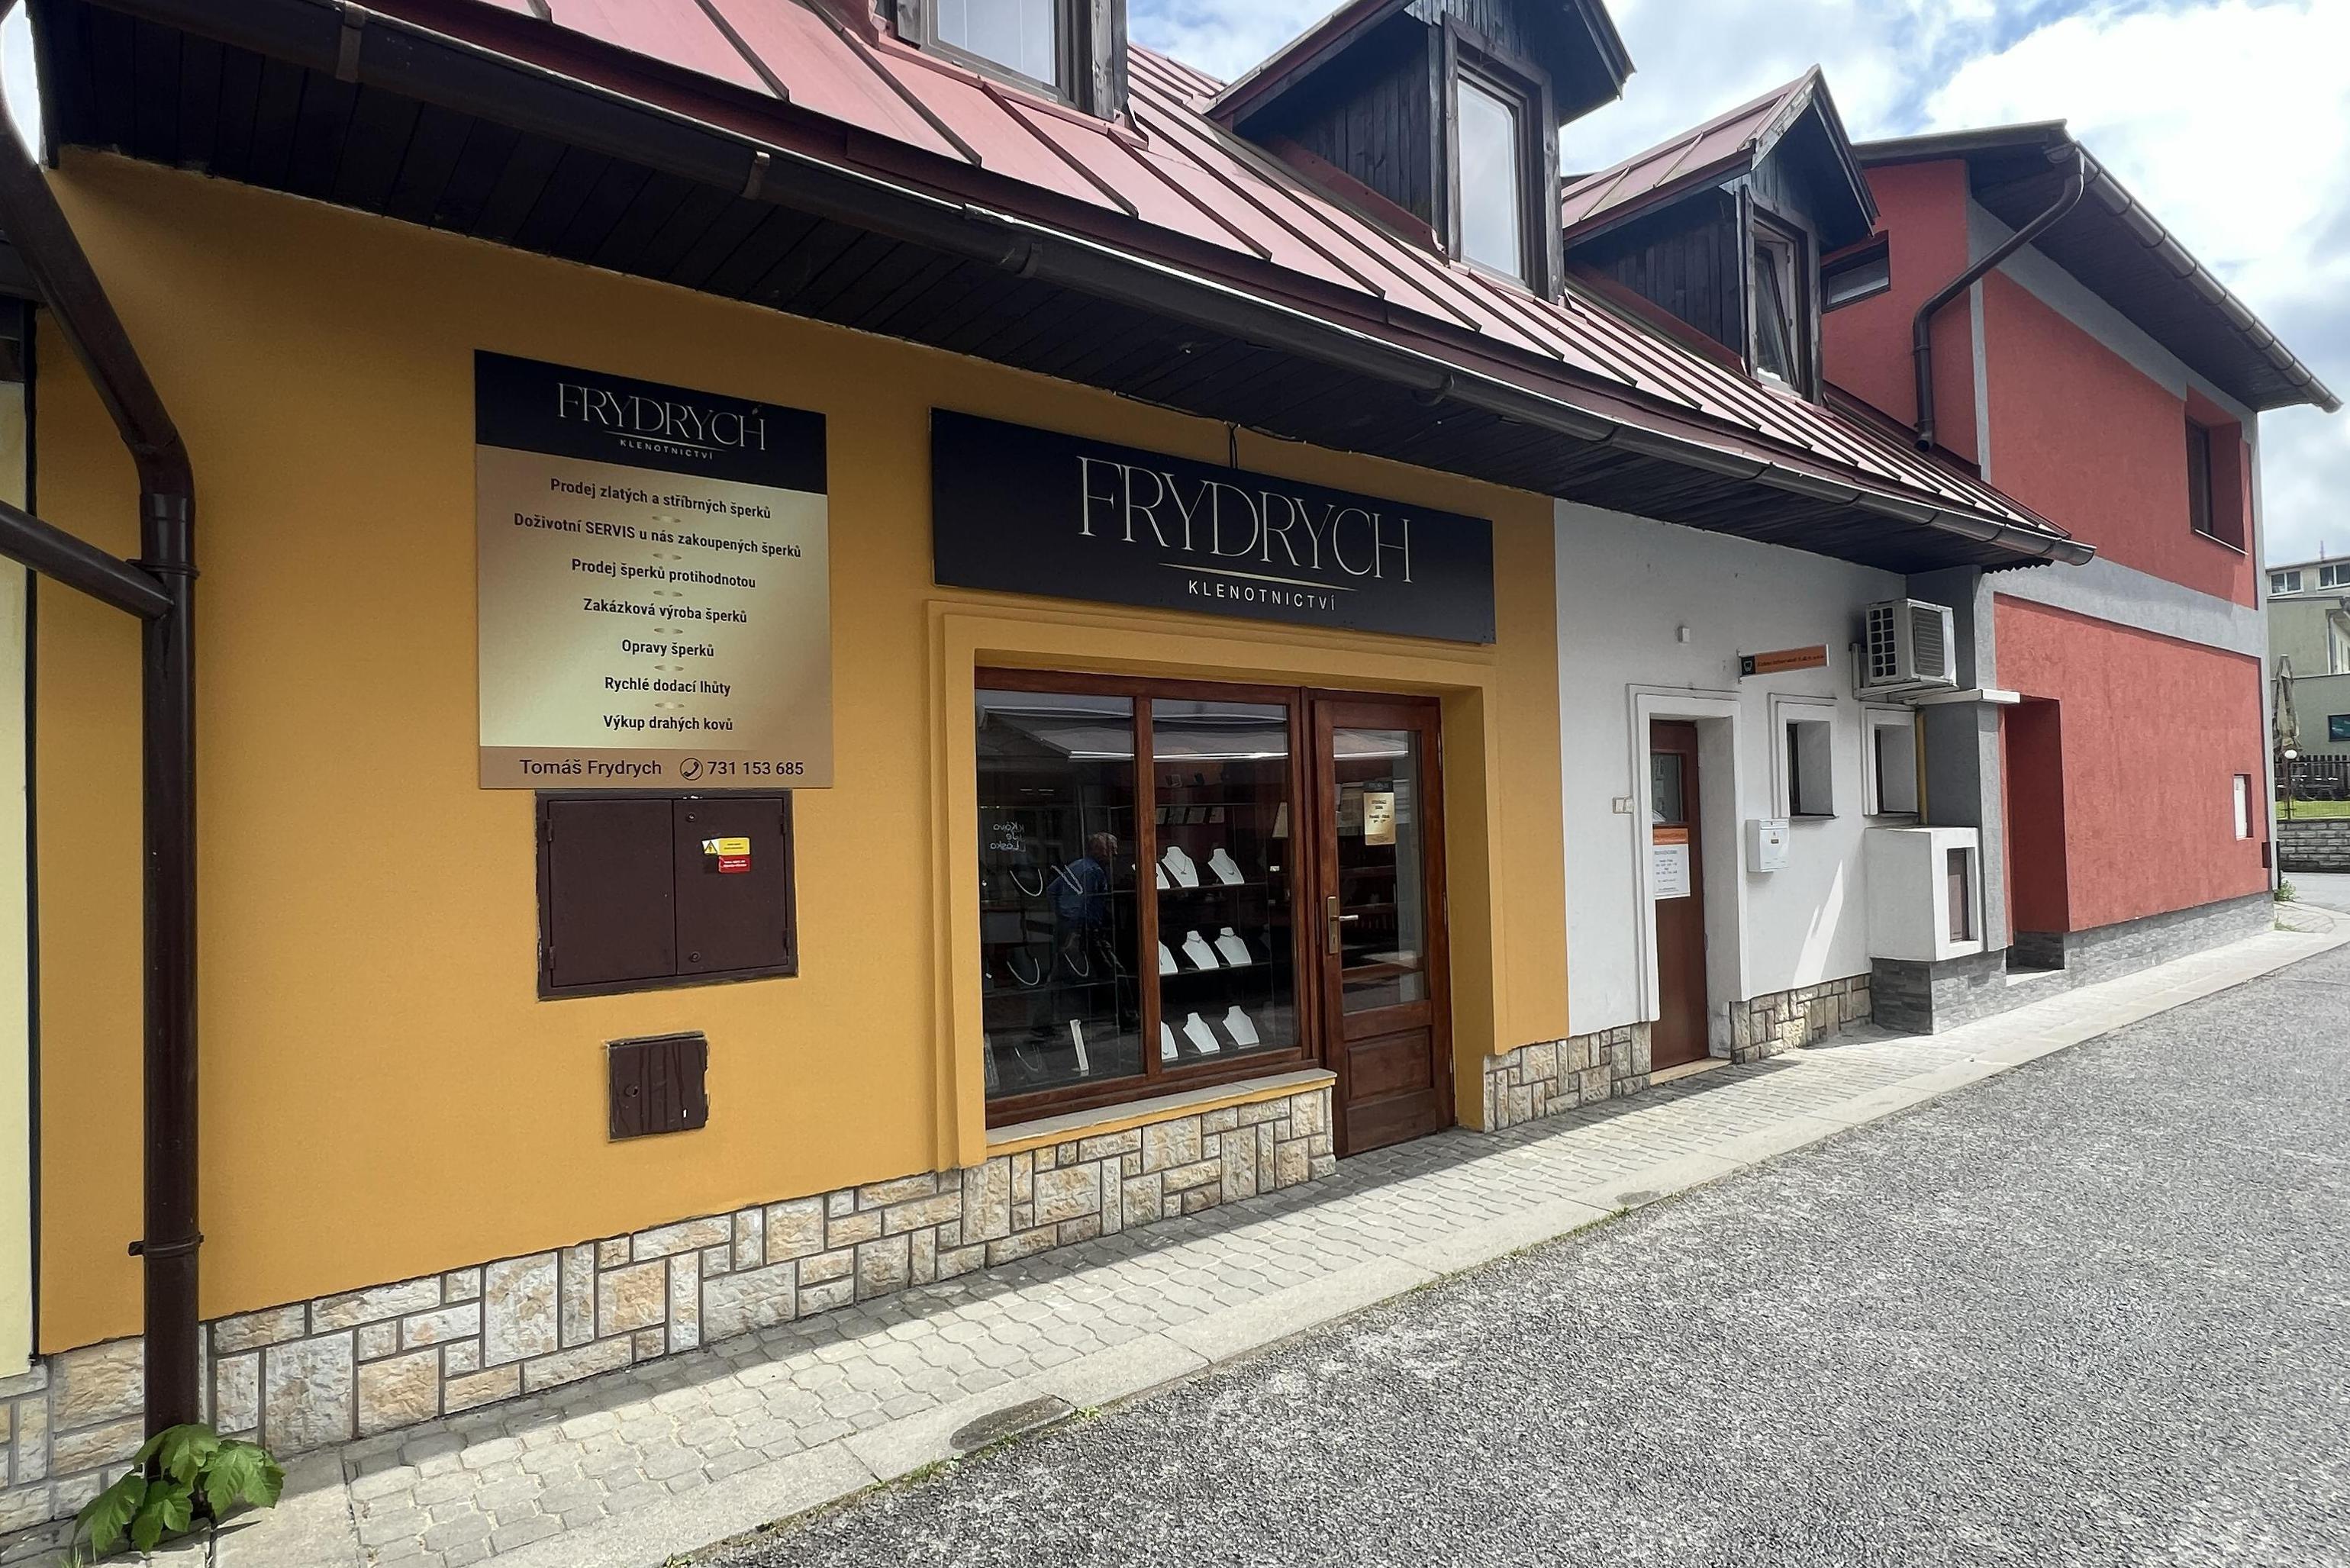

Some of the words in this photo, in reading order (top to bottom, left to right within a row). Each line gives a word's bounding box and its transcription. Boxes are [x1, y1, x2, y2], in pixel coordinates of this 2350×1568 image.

[557, 382, 767, 451] FRYDRYCH
[620, 438, 714, 461] KLENOTNICTVÍ
[550, 478, 596, 498] Prodej
[600, 485, 648, 504] zlatých
[652, 494, 660, 505] a
[662, 493, 727, 514] stříbrných
[730, 504, 771, 520] šperků
[1075, 456, 1415, 583] FRYDRYCH
[514, 512, 582, 533] Doživotní
[585, 522, 635, 539] SERVIS
[639, 530, 647, 541] u
[651, 530, 674, 543] nás
[678, 533, 758, 553] zakoupených
[762, 541, 801, 558] šperků
[571, 559, 617, 577] Prodej
[620, 564, 665, 581] šperků
[669, 569, 756, 589] protihodnotou
[1188, 578, 1337, 612] KLENOTNICTVÍ
[583, 598, 656, 617] Zakázková
[659, 602, 701, 620] výroba
[705, 607, 747, 623] šperků
[622, 639, 667, 657] Opravy
[671, 642, 714, 658] šperků
[604, 676, 650, 694] Rychlé
[653, 679, 696, 694] dodací
[700, 680, 730, 697] lhůty
[604, 714, 645, 731] Výkup
[649, 716, 700, 732] drahých
[704, 717, 733, 732] kovů
[520, 758, 582, 775] Tomáš
[588, 759, 662, 778] Frydrych
[708, 761, 737, 775] 731
[743, 761, 771, 775] 153
[775, 761, 804, 775] 685
